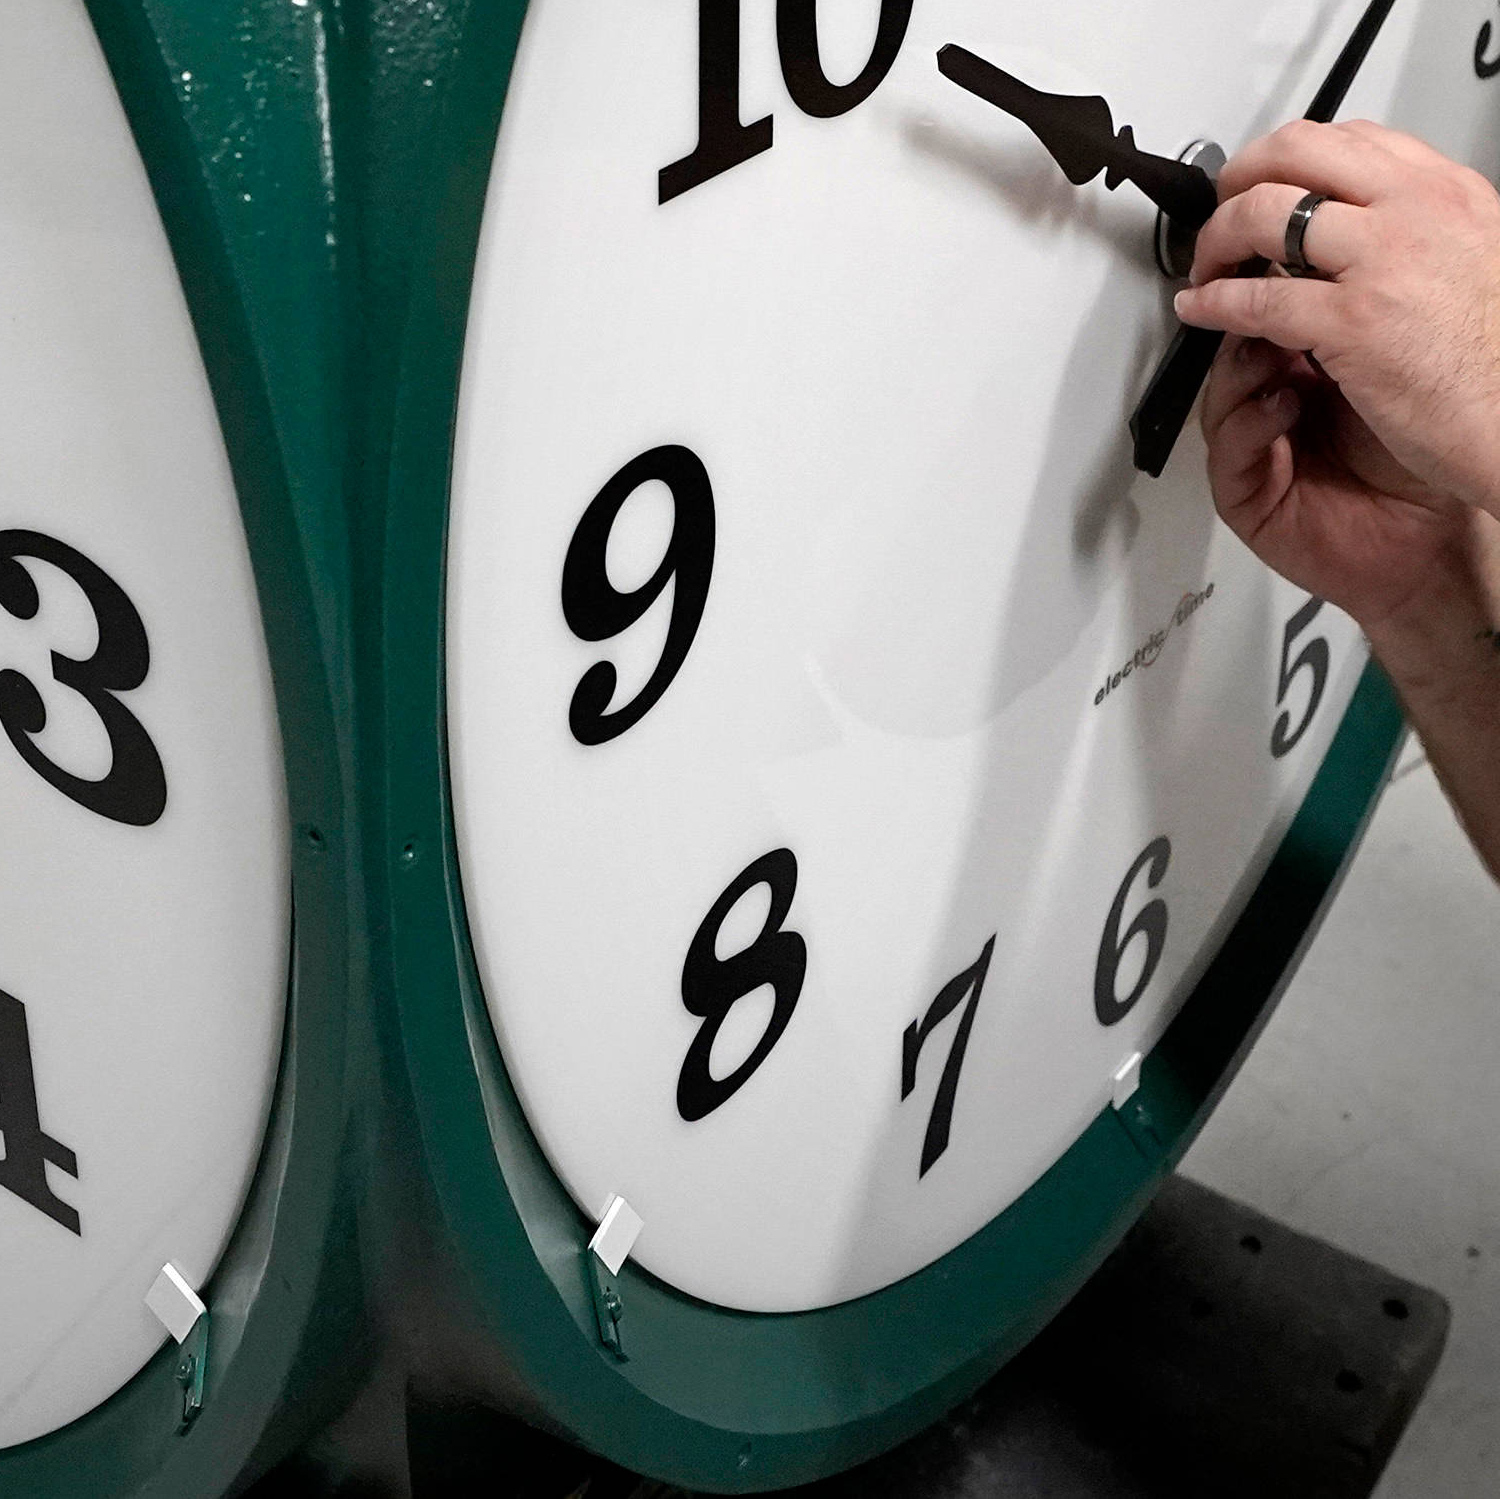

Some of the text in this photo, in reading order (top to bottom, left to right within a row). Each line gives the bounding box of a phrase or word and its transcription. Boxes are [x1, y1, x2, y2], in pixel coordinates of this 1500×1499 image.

[560, 444, 716, 747] 9
[1094, 628, 1165, 706] electric
[1270, 595, 1330, 760] 5
[676, 847, 808, 1123] 8
[1093, 834, 1173, 1027] 6
[900, 933, 997, 1181] 7
